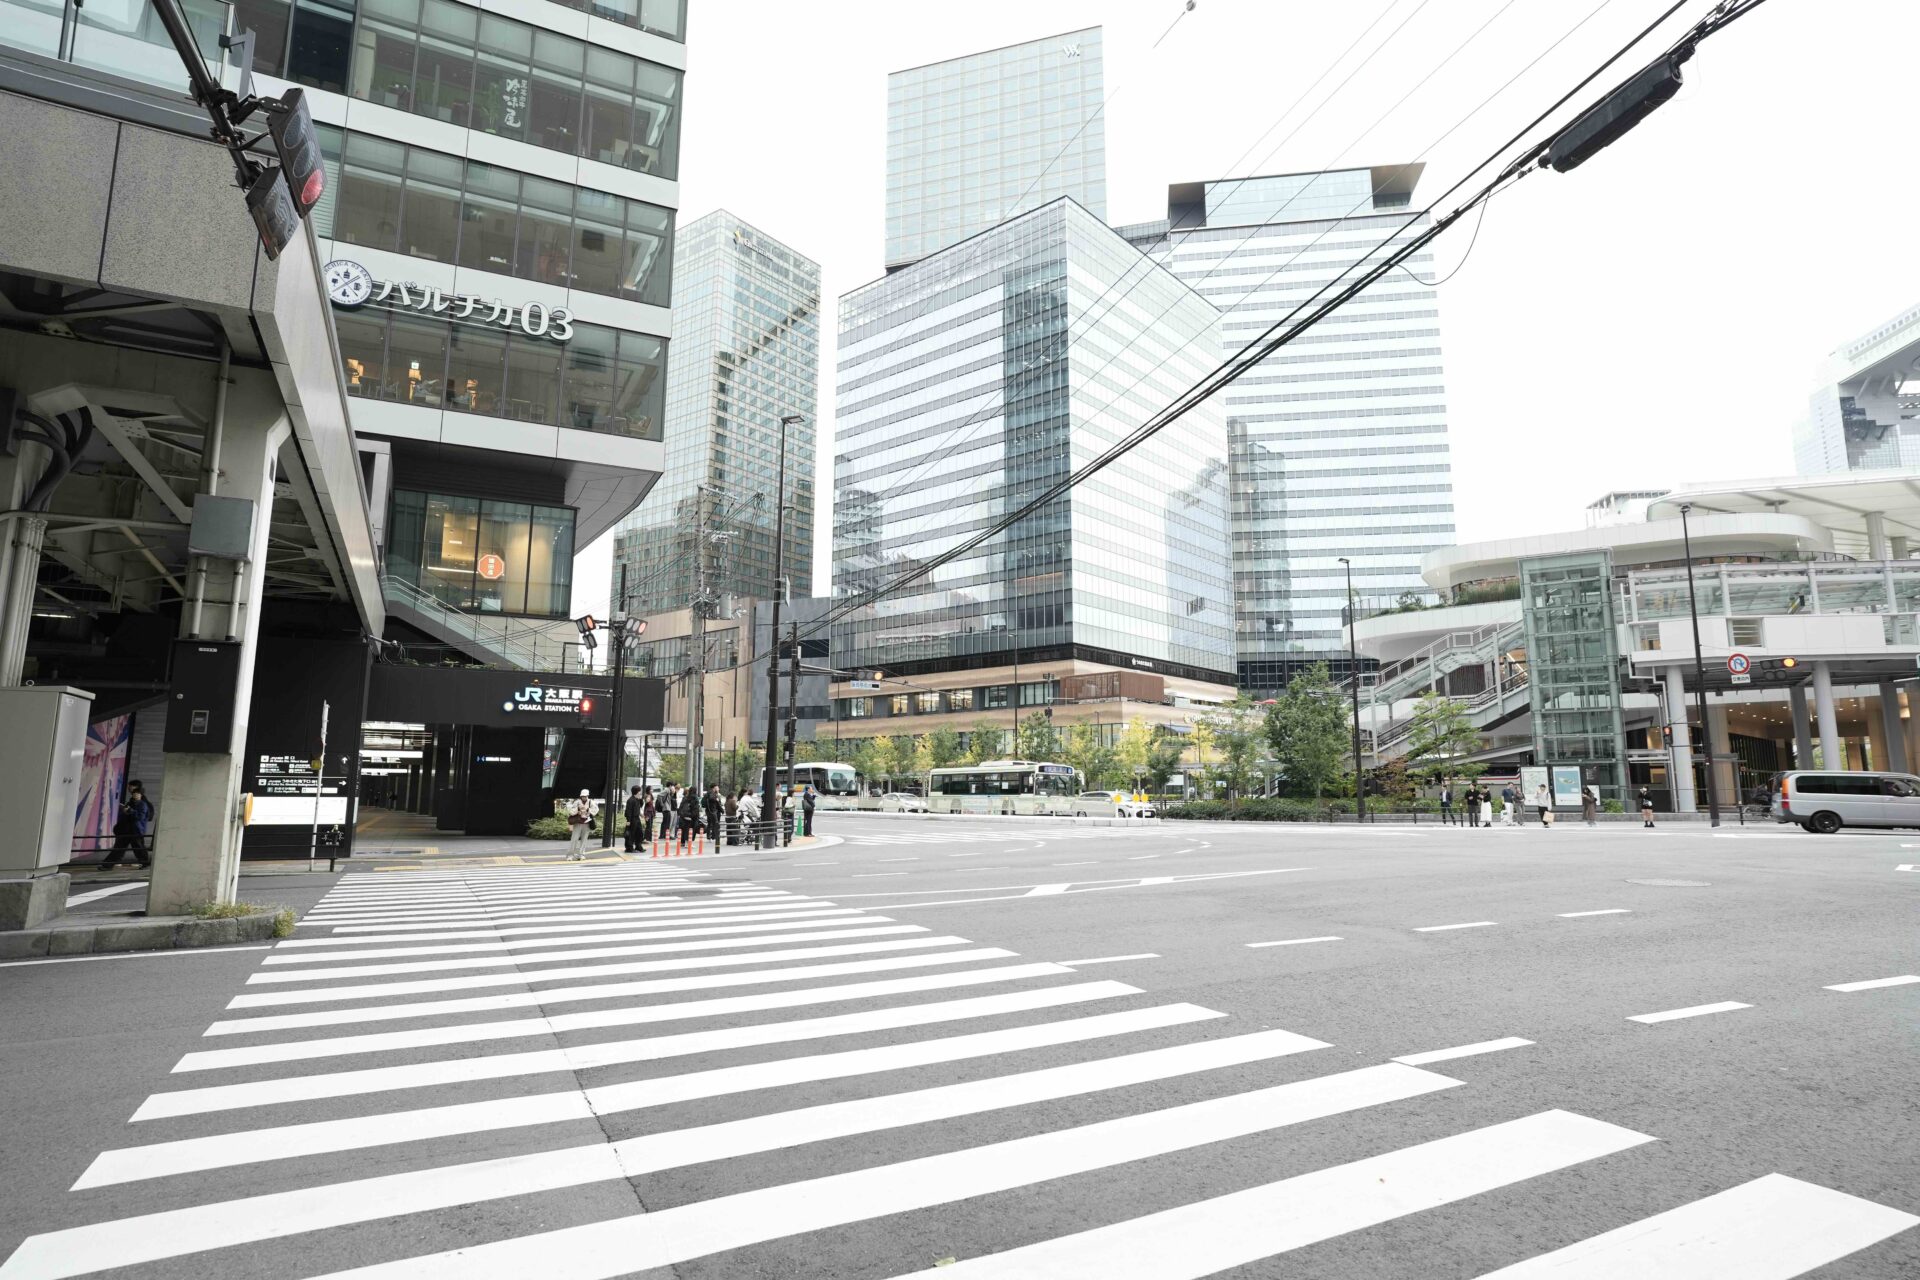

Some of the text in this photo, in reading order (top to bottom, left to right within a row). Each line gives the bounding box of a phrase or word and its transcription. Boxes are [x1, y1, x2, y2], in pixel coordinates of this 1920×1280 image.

[375, 279, 575, 341] バルチカ03
[515, 687, 543, 702] JR
[544, 704, 572, 712] STATION
